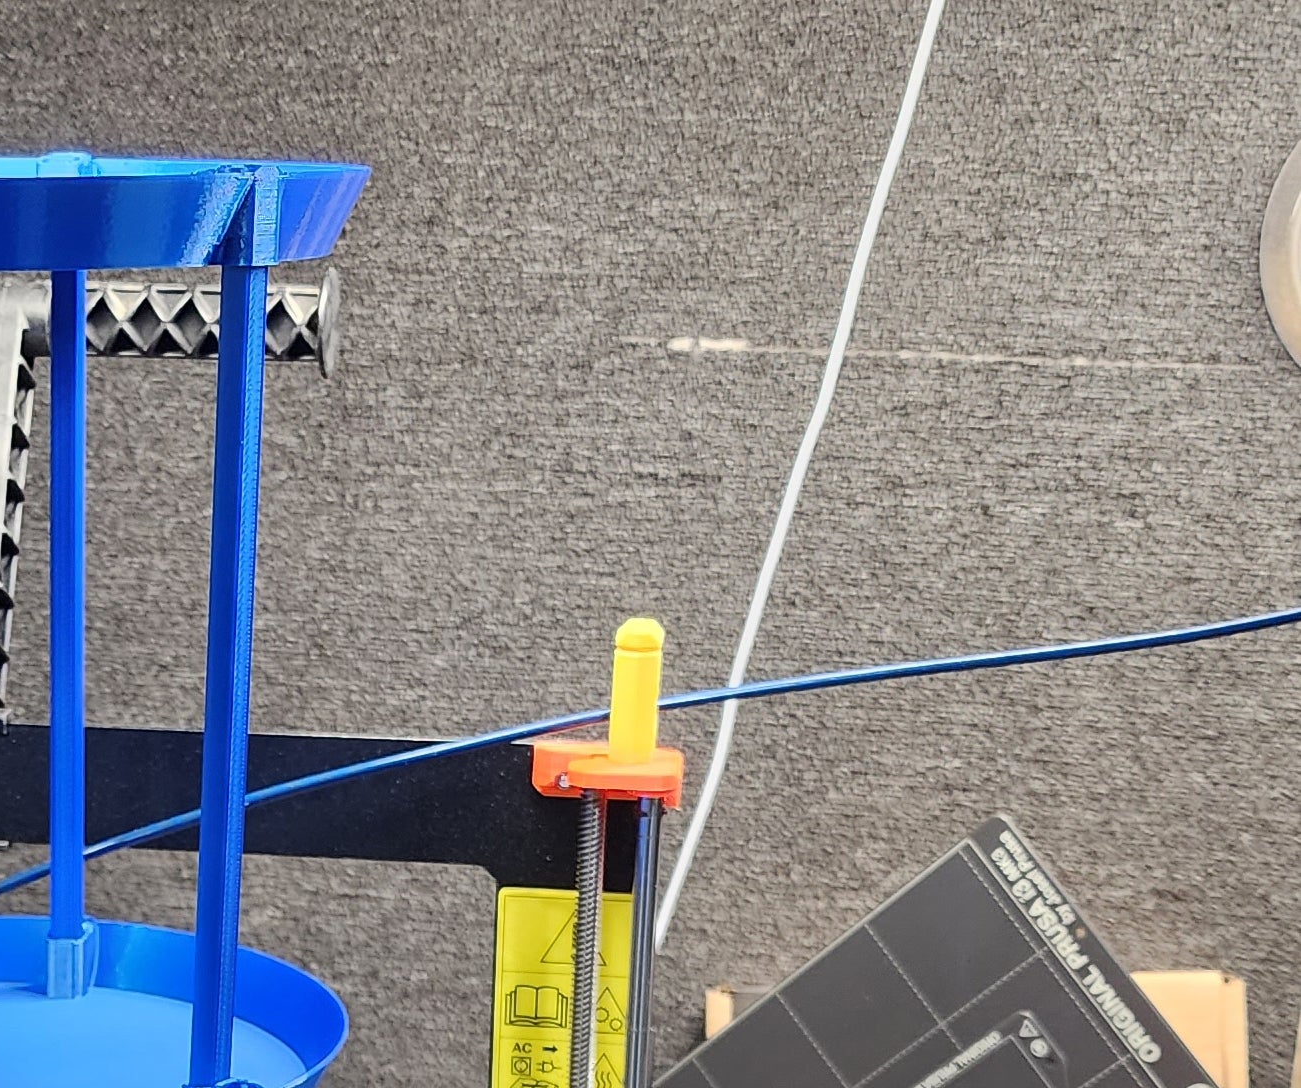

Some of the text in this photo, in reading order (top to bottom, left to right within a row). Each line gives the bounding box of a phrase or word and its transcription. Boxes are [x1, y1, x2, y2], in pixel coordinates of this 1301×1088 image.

[1029, 897, 1089, 970] PRUSA
[511, 1043, 532, 1053] AC
[1082, 965, 1161, 1062] ORIGINAL
